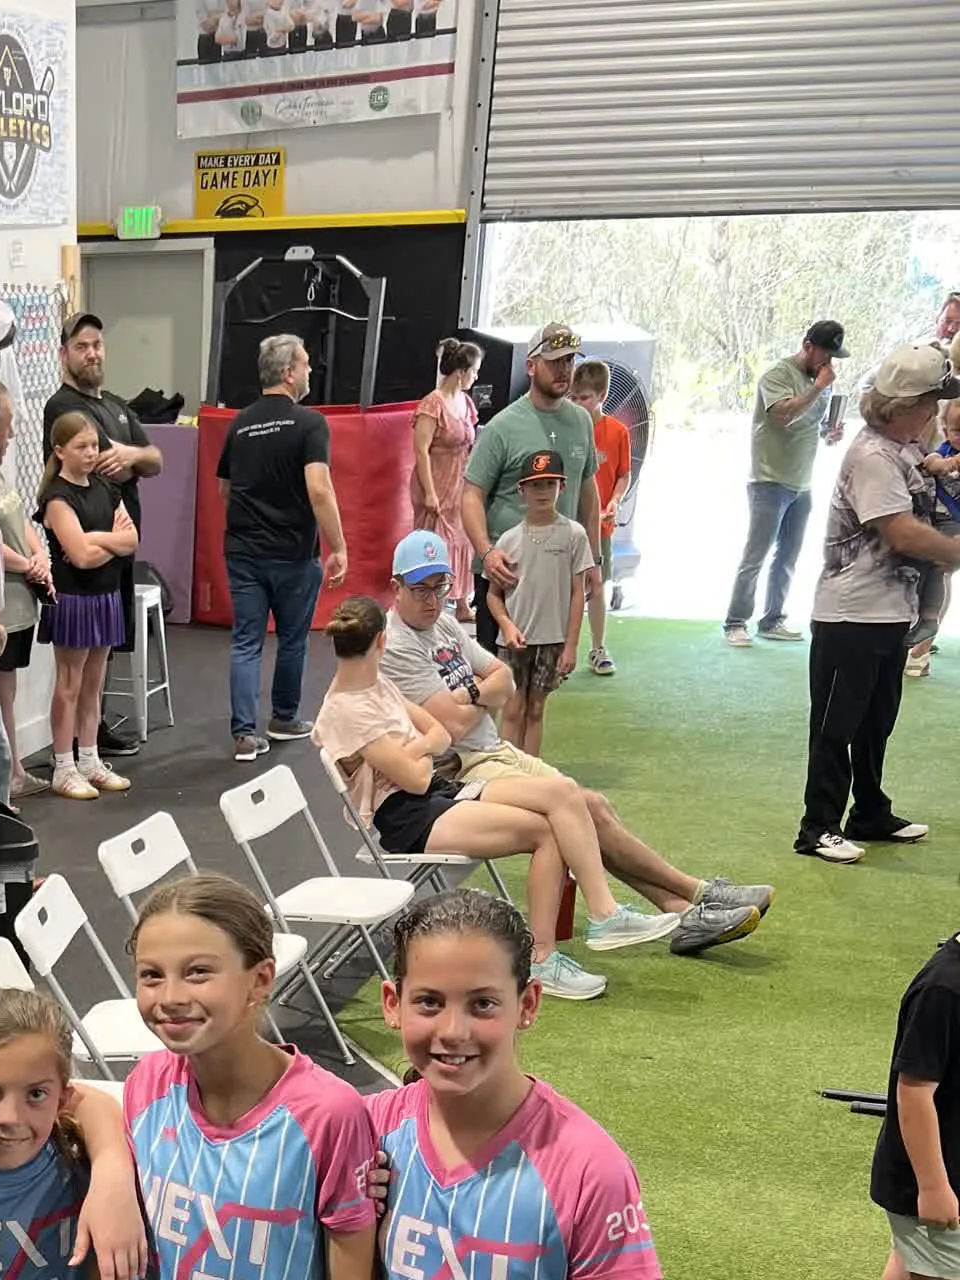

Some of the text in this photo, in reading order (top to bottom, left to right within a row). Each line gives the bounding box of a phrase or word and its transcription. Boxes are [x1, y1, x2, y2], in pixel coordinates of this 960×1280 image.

[200, 153, 278, 168] MAKE EVERY DAY
[200, 168, 278, 189] GAME DAY!
[123, 206, 154, 238] EXIT
